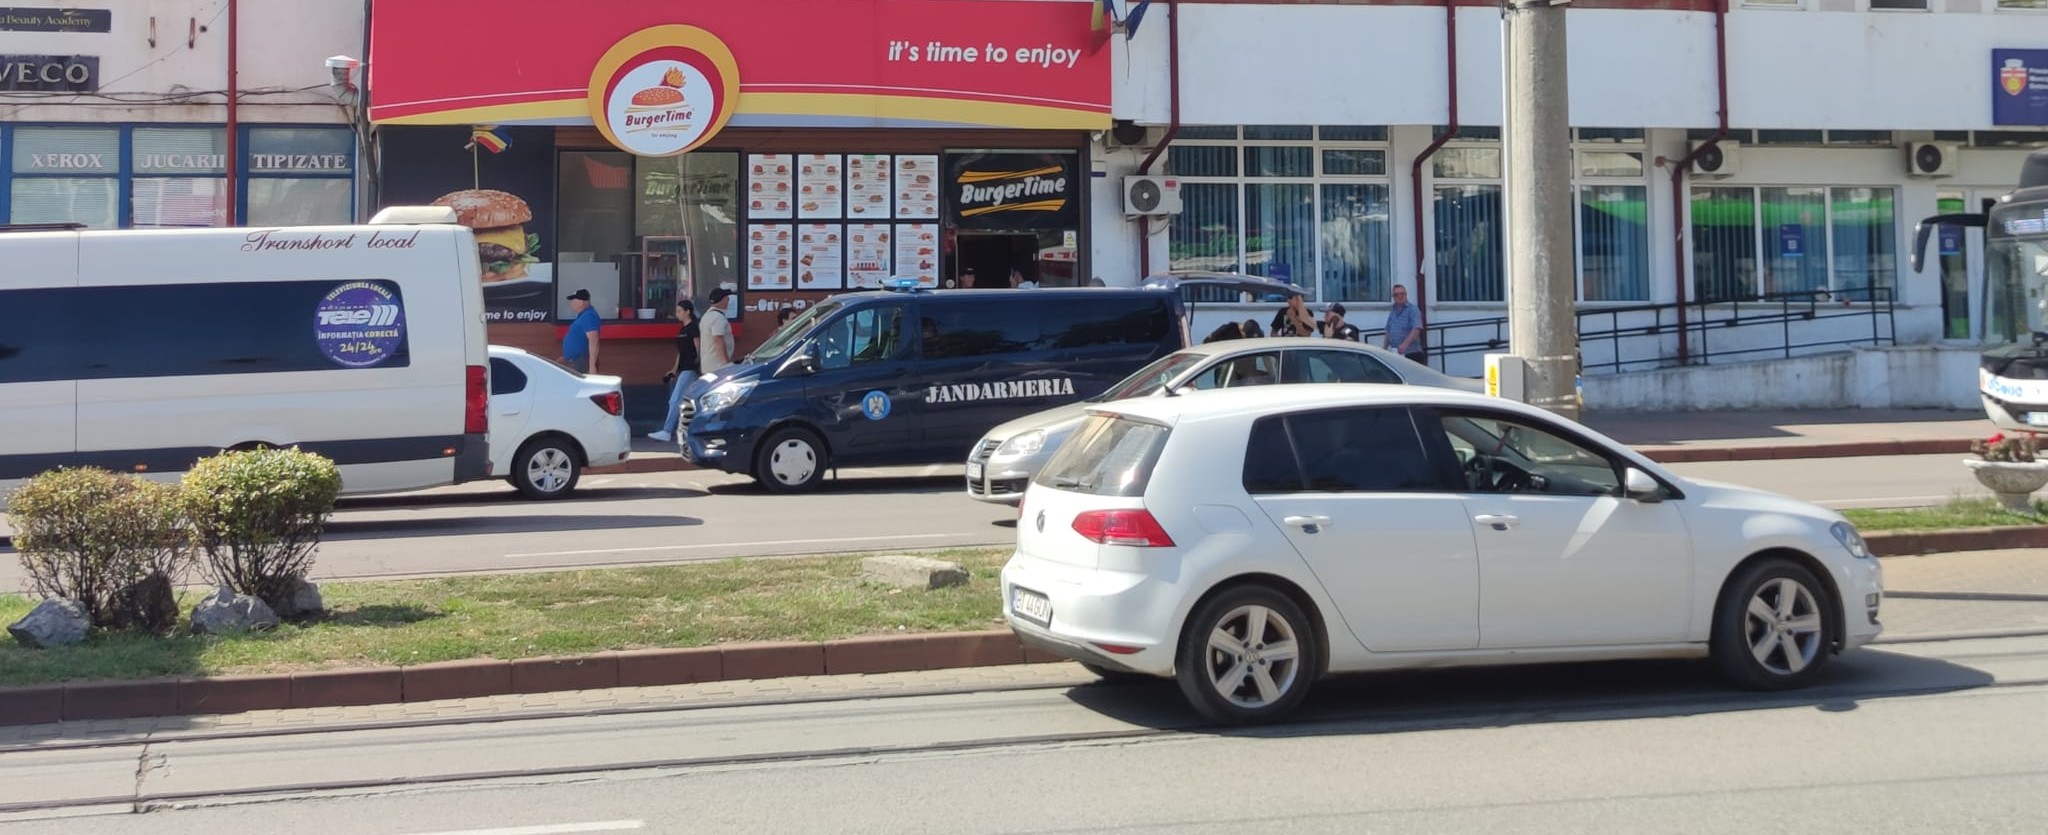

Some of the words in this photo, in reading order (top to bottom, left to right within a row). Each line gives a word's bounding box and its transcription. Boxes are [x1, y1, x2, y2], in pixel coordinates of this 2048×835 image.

[7, 15, 41, 26] Beauty
[888, 40, 920, 62] it's
[926, 42, 979, 63] time
[985, 43, 1008, 63] to
[1015, 44, 1081, 69] enjoy
[625, 109, 693, 128] BurgerTime
[31, 153, 104, 168] XEROX
[141, 154, 226, 169] JUCARII
[253, 154, 347, 169] TIPIZATE
[960, 176, 1067, 206] BurgerTime
[240, 229, 356, 252] Transport
[367, 229, 422, 249] local
[485, 311, 501, 320] me
[503, 310, 515, 320] to
[516, 309, 548, 322] enjoy
[925, 378, 1075, 404] JANDARMERIA
